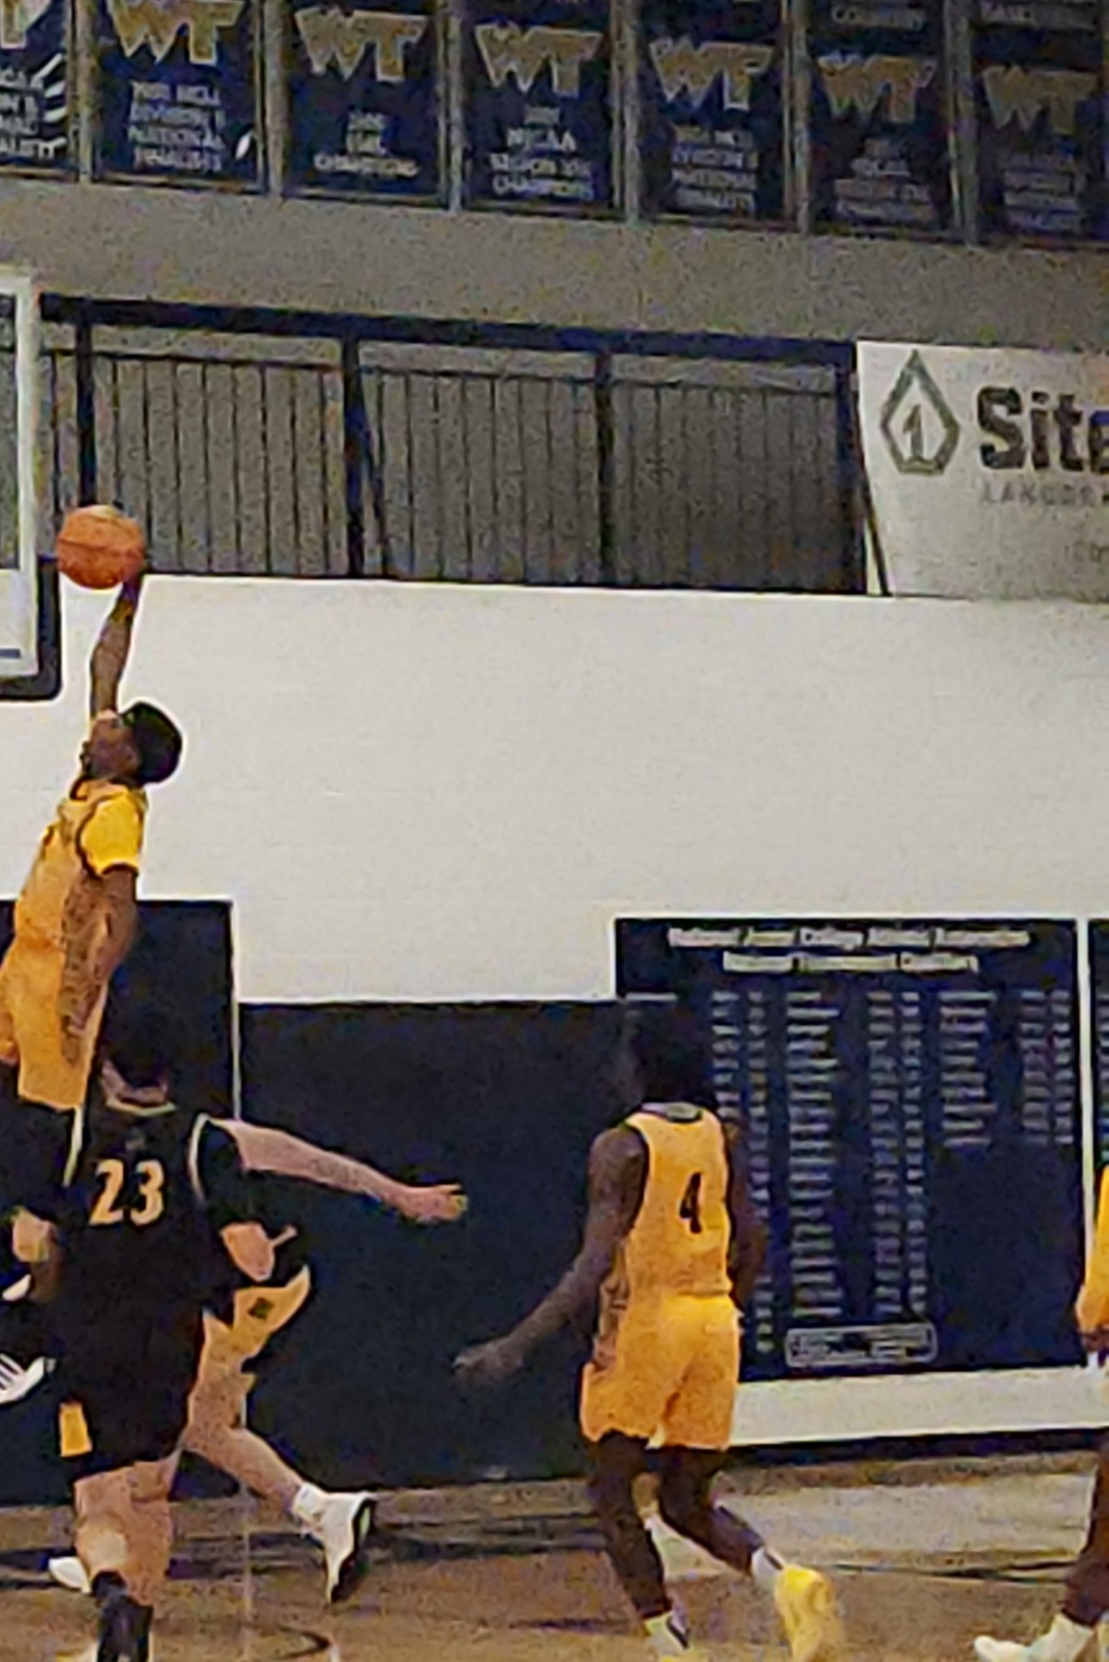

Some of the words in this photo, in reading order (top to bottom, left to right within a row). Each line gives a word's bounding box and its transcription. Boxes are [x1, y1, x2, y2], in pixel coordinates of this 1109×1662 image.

[294, 7, 427, 82] WT
[475, 24, 603, 97] WT
[649, 37, 773, 112] WT
[817, 53, 938, 124] WT
[89, 1159, 164, 1226] 23
[679, 1172, 702, 1234] 4
